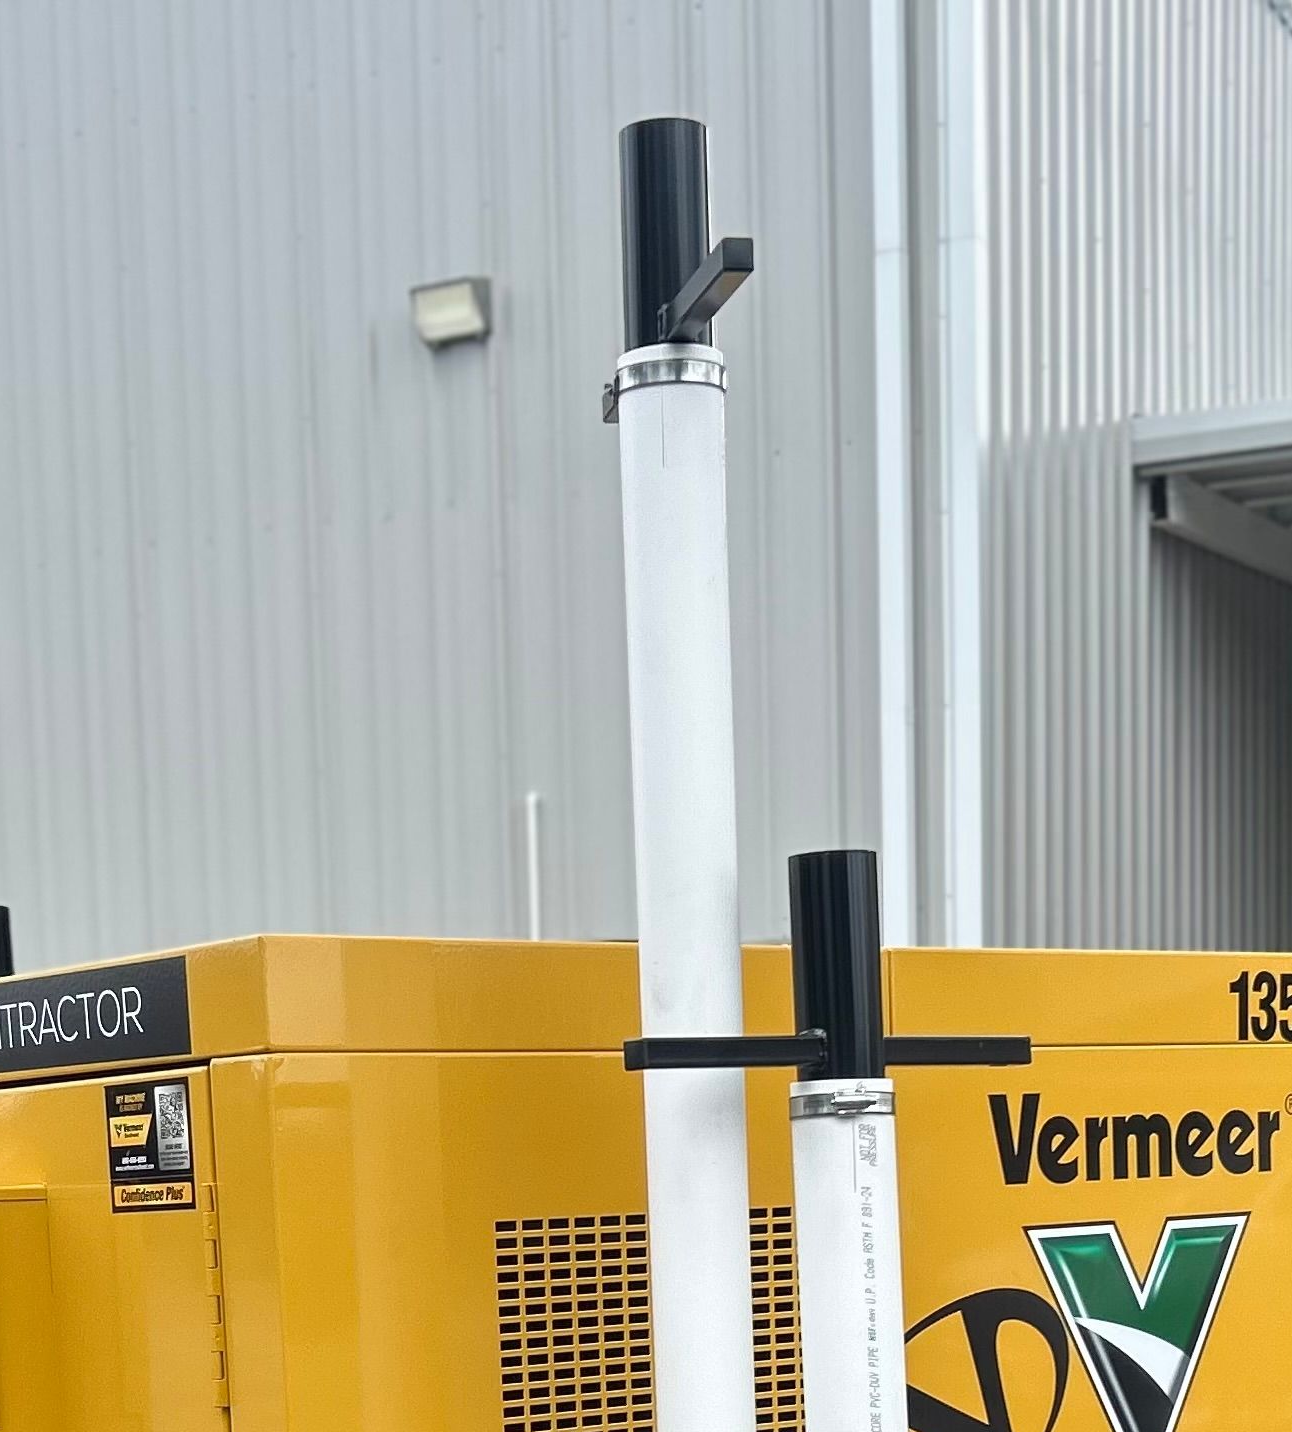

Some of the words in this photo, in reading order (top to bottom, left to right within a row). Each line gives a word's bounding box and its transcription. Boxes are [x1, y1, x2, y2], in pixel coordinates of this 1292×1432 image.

[864, 1258, 875, 1279] Code
[867, 1346, 879, 1369] PIPE
[871, 1412, 882, 1432] CORE
